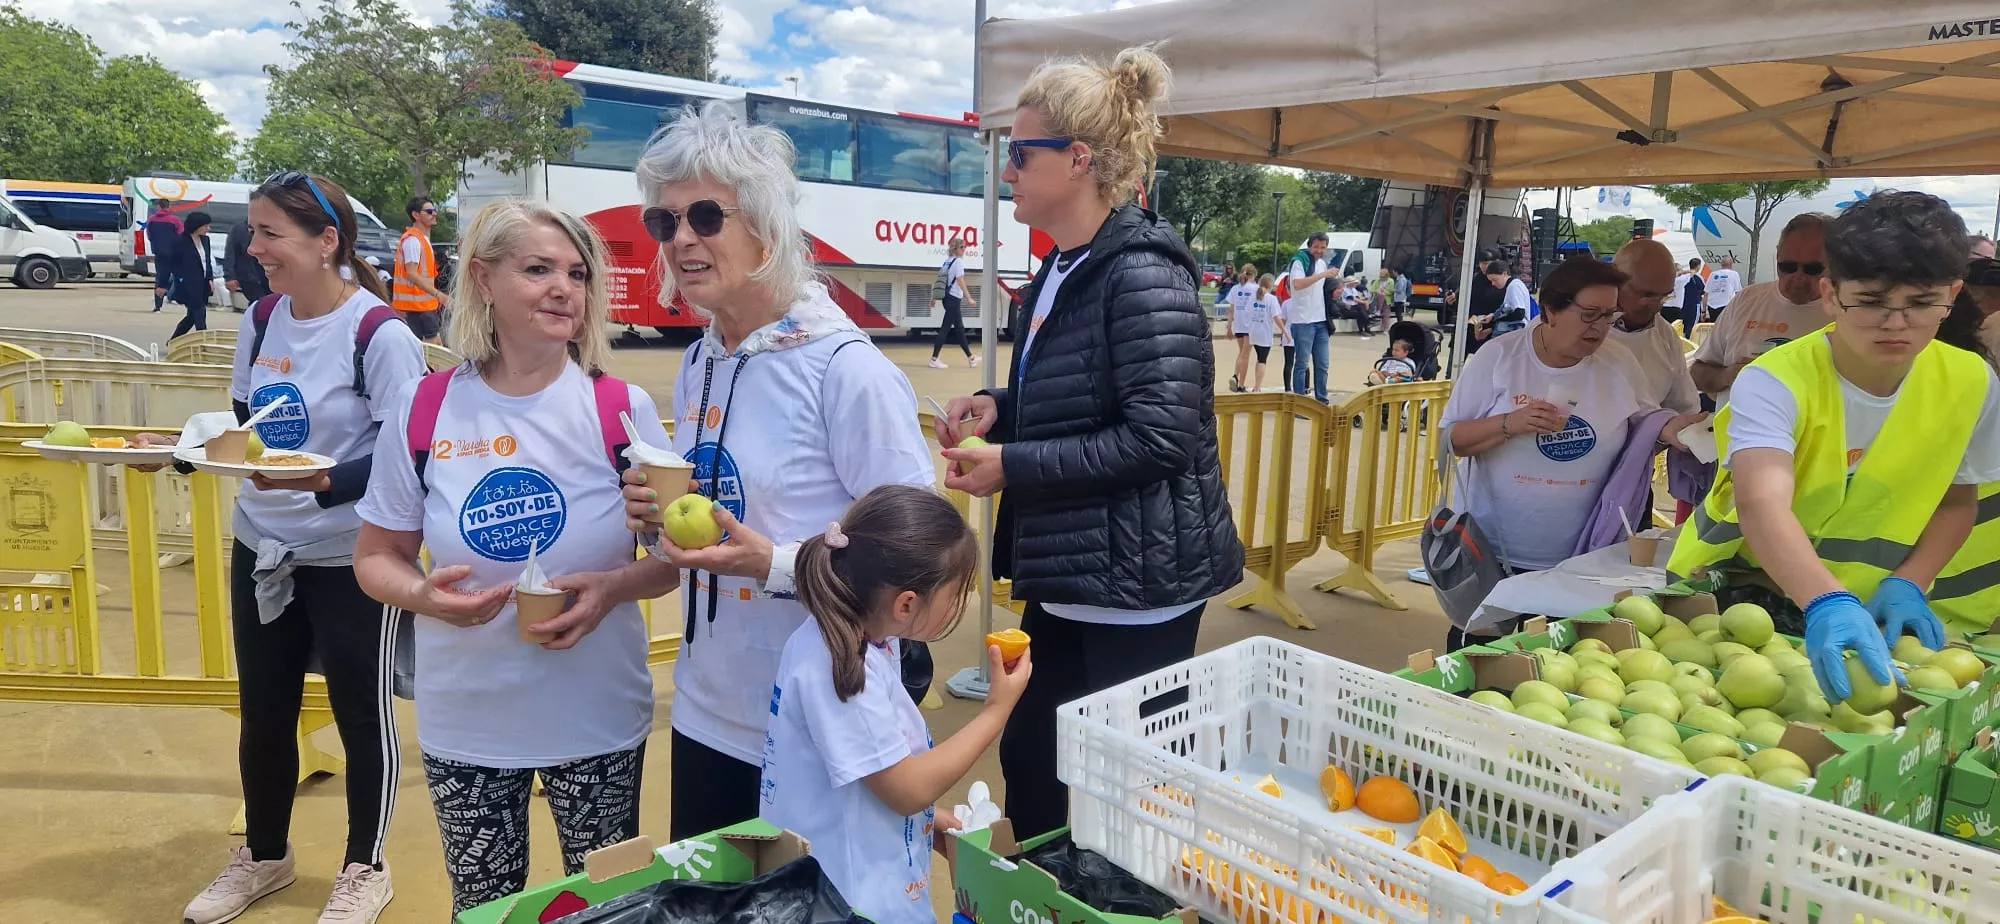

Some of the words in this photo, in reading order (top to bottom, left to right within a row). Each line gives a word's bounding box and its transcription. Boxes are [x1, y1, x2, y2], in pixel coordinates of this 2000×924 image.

[789, 106, 848, 121] avanzabus.com
[875, 219, 978, 247] avanza
[1513, 394, 1528, 405] 12
